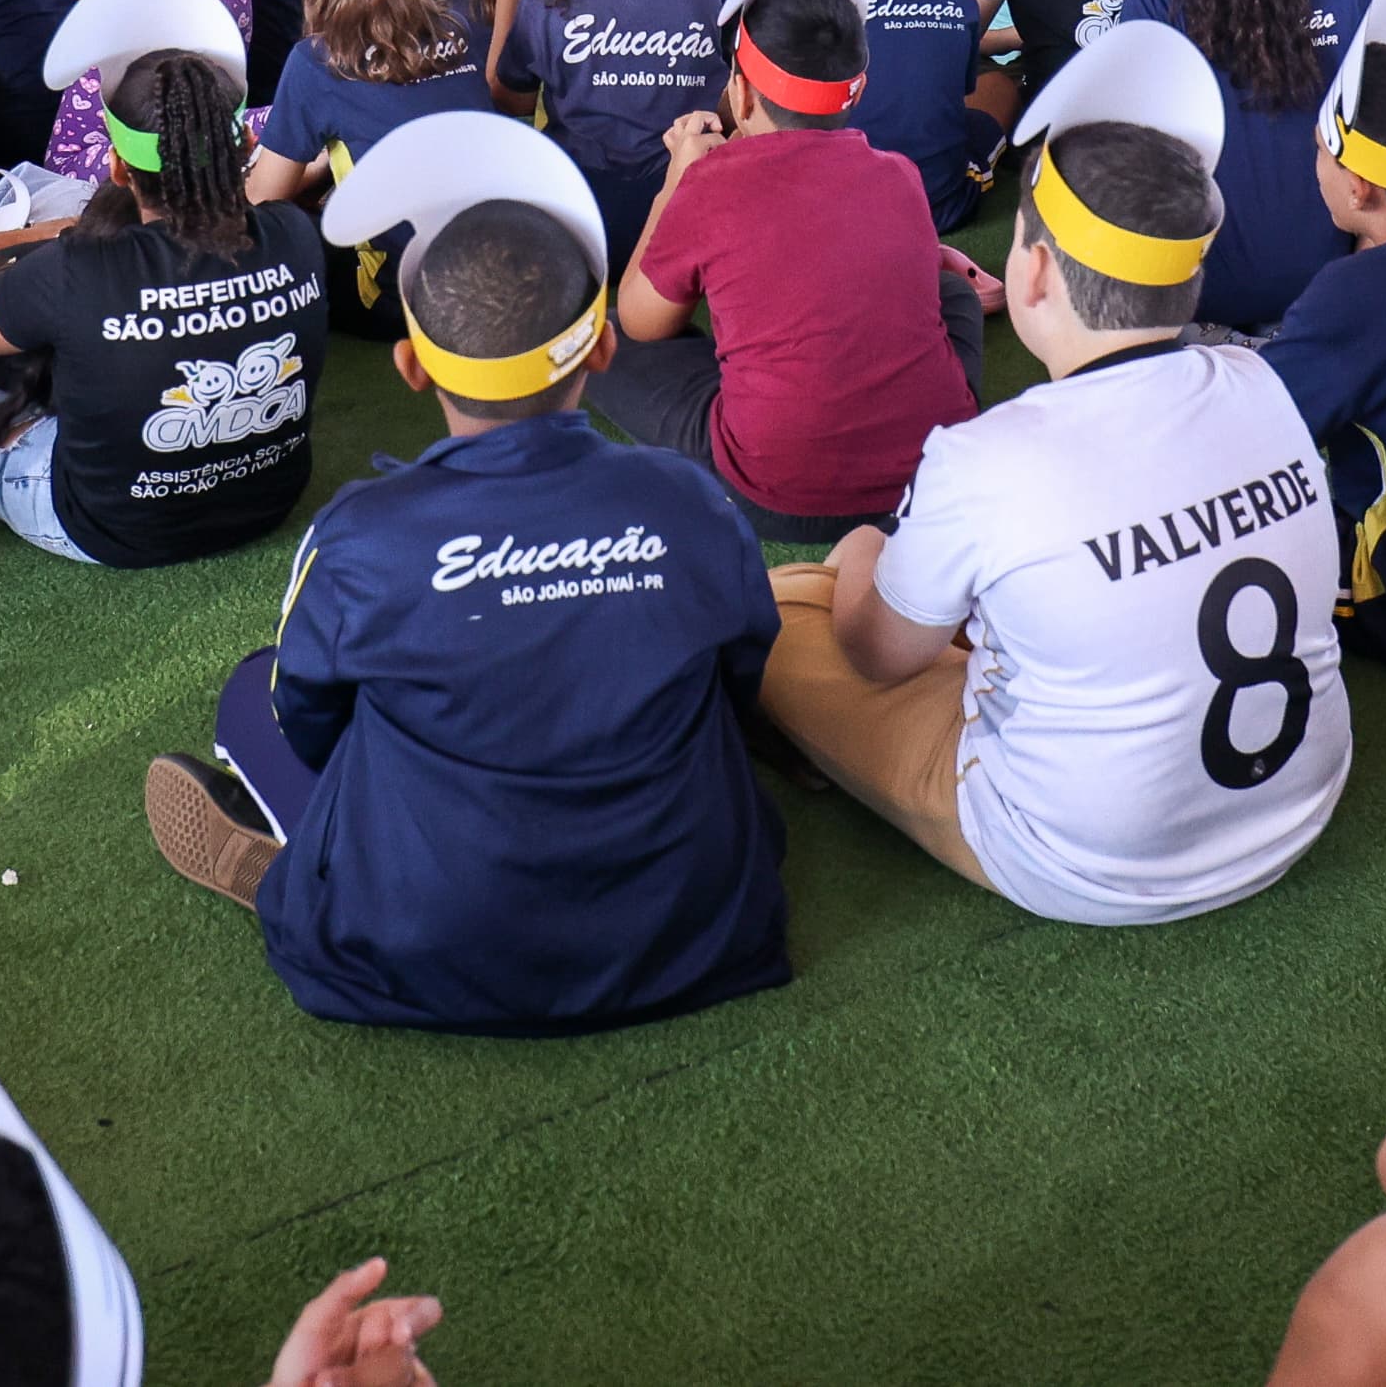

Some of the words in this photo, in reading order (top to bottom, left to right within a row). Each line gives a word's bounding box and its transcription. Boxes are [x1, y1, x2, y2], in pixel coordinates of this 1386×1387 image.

[563, 14, 716, 67] Educação
[884, 21, 903, 30] SÃO
[904, 21, 926, 29] JOÃO
[592, 71, 618, 86] SÃO
[621, 71, 655, 86] JOÃO
[658, 73, 674, 86] DO
[102, 314, 163, 341] SÃO
[171, 305, 246, 339] JOÃO
[252, 296, 287, 323] DO
[290, 273, 321, 311] IVAÍ
[140, 263, 294, 311] PREFEITURA
[131, 485, 169, 499] SÃO
[174, 476, 218, 494] JOÃO
[222, 466, 248, 481] DO
[136, 453, 251, 484] ASSISTÊNCIA
[1082, 460, 1317, 582] VALVERDE
[432, 525, 667, 592] Educação
[502, 586, 535, 606] SÃO
[537, 578, 579, 602] JOÃO
[581, 579, 604, 596] DO
[606, 572, 634, 593] IVAÍ
[644, 574, 664, 591] PR
[1197, 556, 1313, 790] 8
